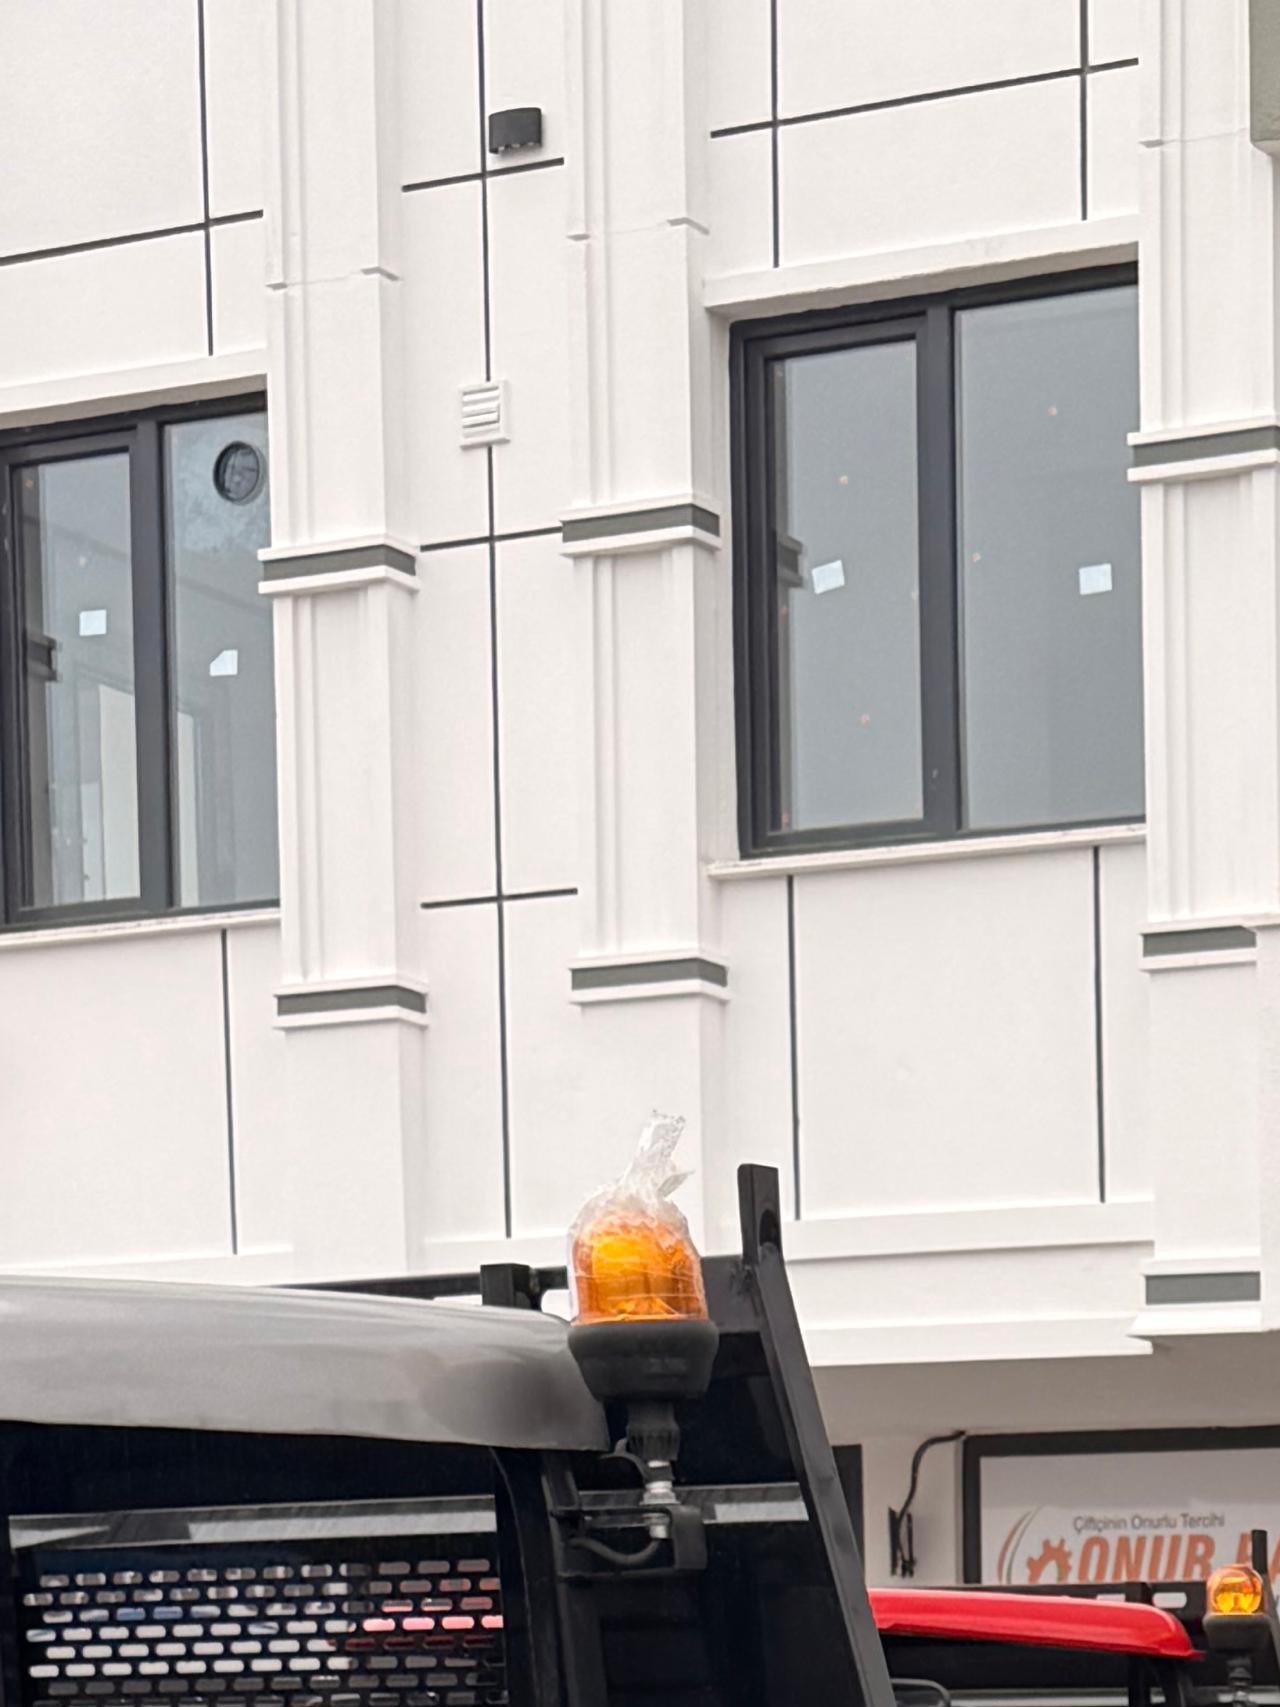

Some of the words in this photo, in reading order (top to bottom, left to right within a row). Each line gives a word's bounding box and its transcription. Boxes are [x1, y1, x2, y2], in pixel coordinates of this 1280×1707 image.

[1073, 1515, 1128, 1534] Çiftçinin
[1131, 1513, 1177, 1530] Onurlu
[1181, 1511, 1225, 1528] Tercihi
[1077, 1534, 1216, 1584] ONUR
